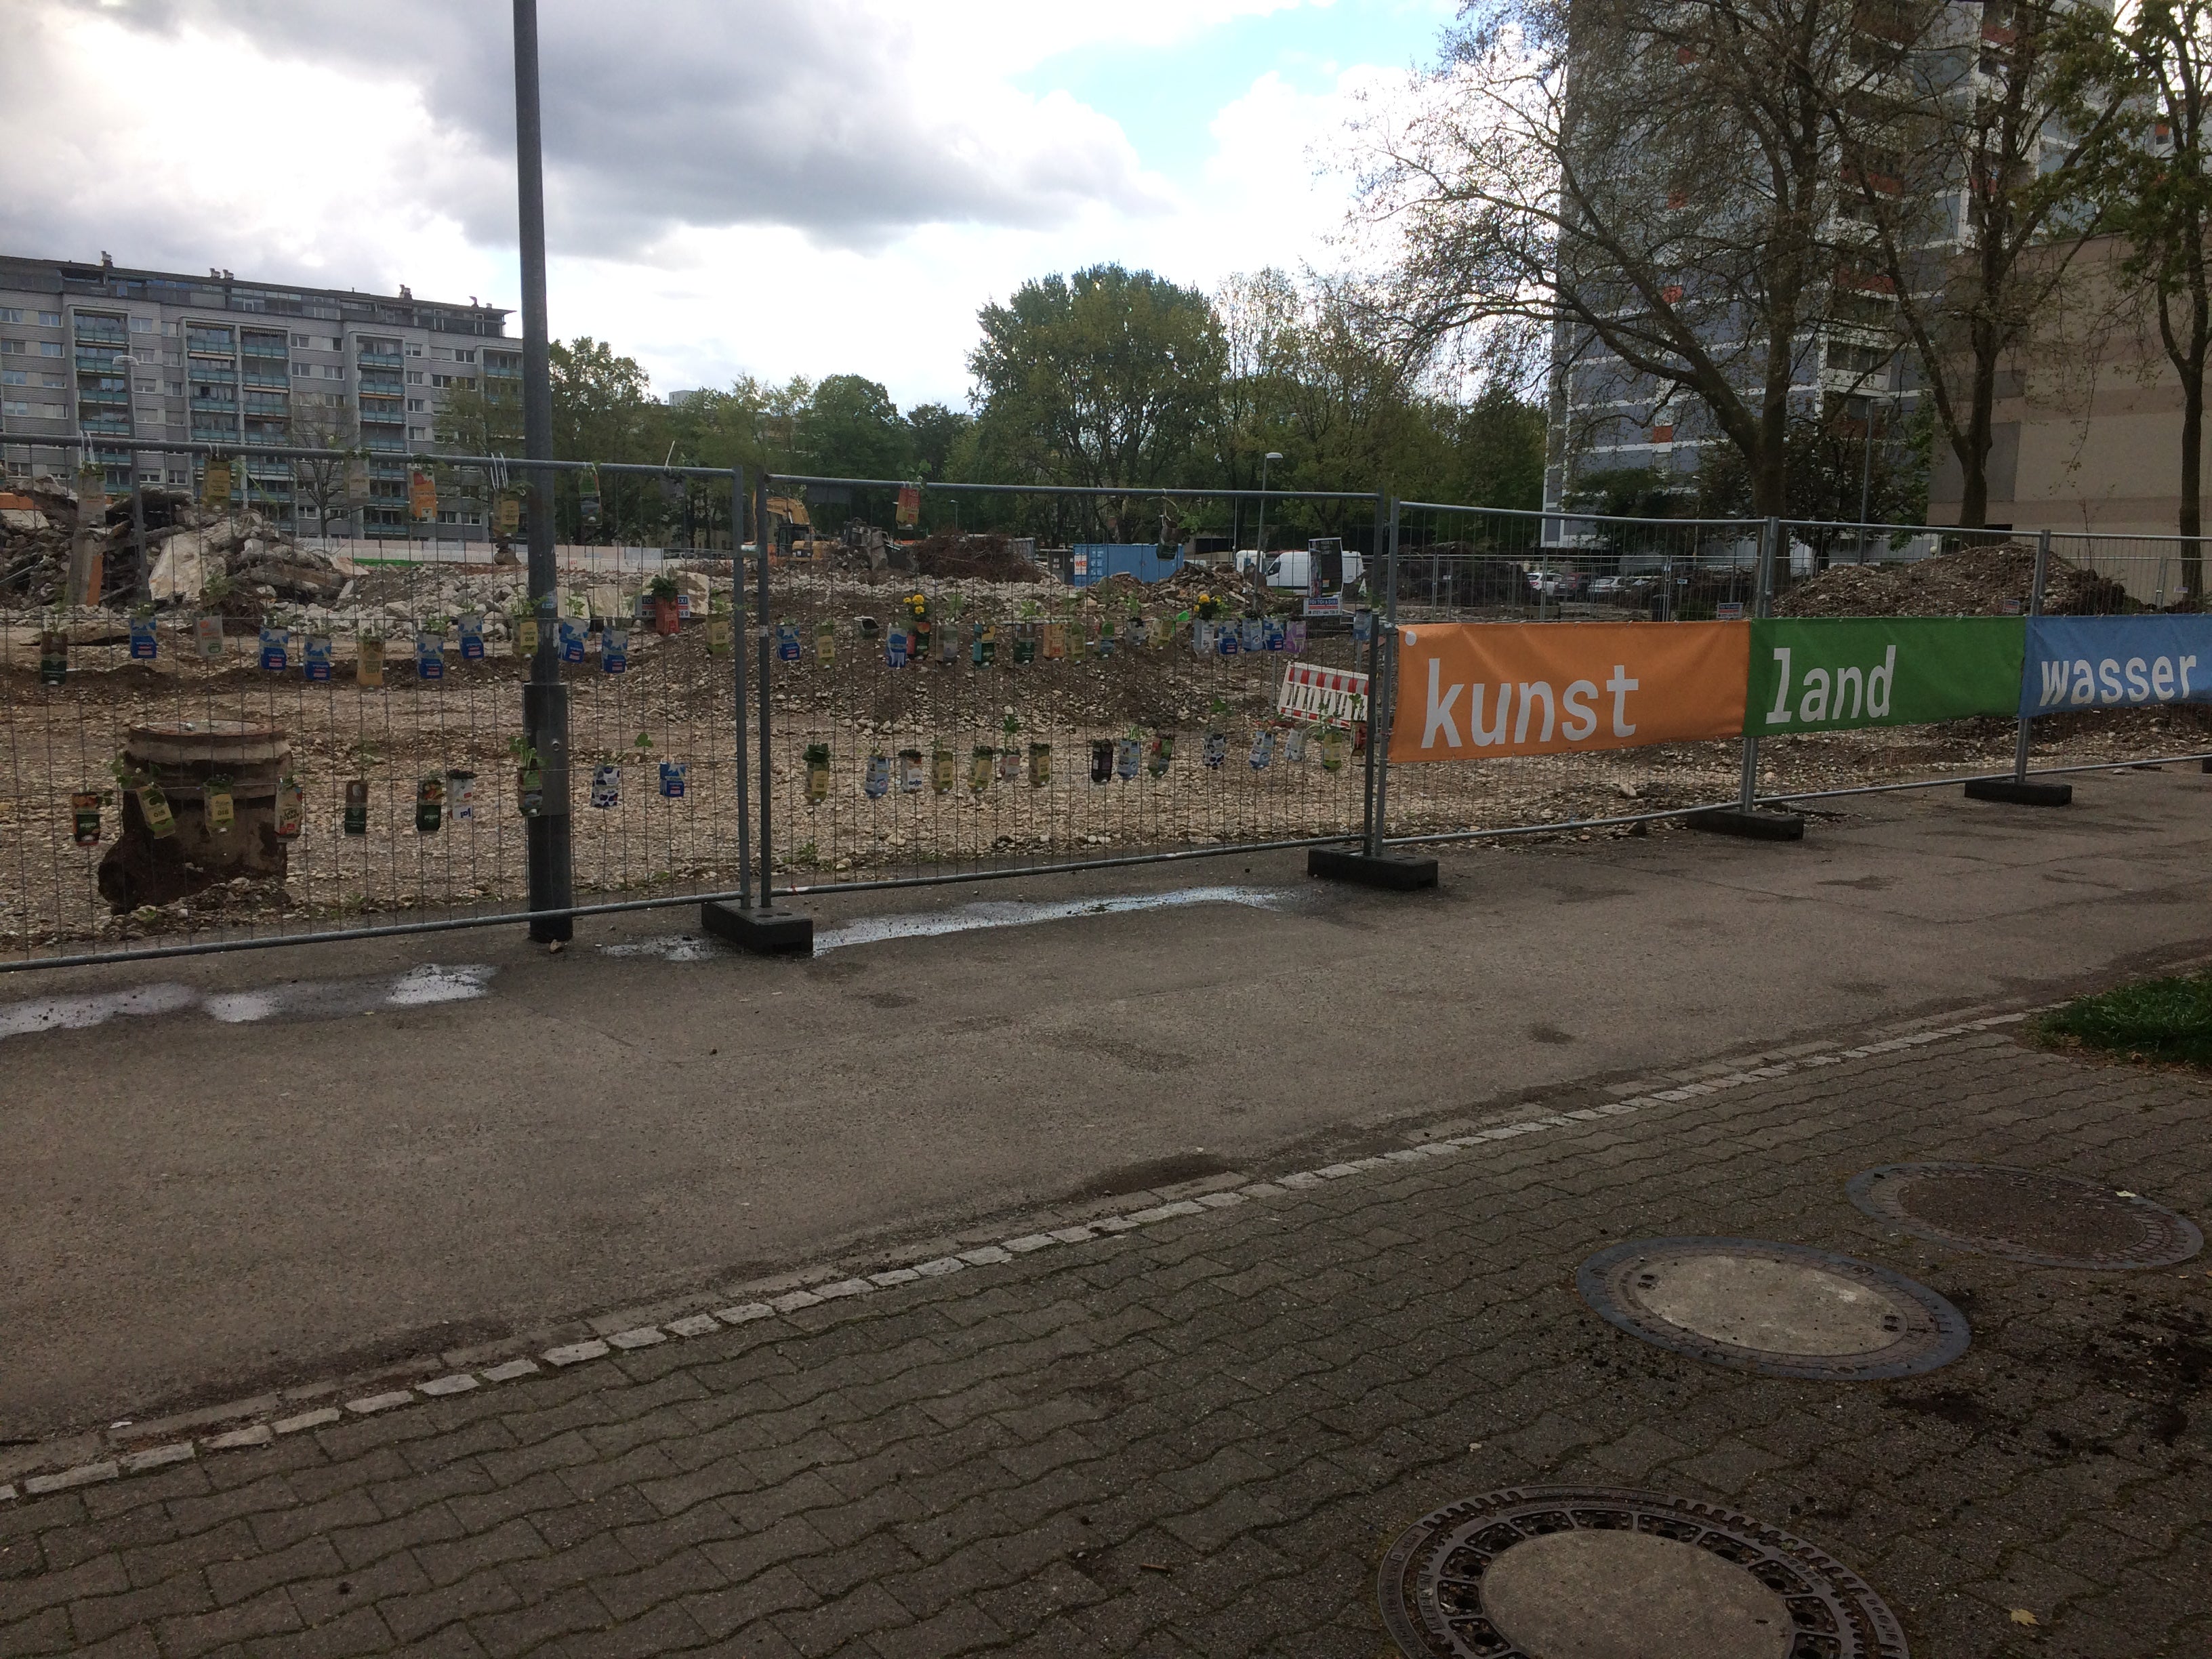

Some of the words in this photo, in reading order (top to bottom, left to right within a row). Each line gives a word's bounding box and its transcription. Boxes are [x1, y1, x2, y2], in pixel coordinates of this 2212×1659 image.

[1421, 657, 1640, 749] kunst
[1765, 645, 1897, 724] land
[2039, 654, 2196, 707] wasser
[459, 808, 472, 819] ja!
